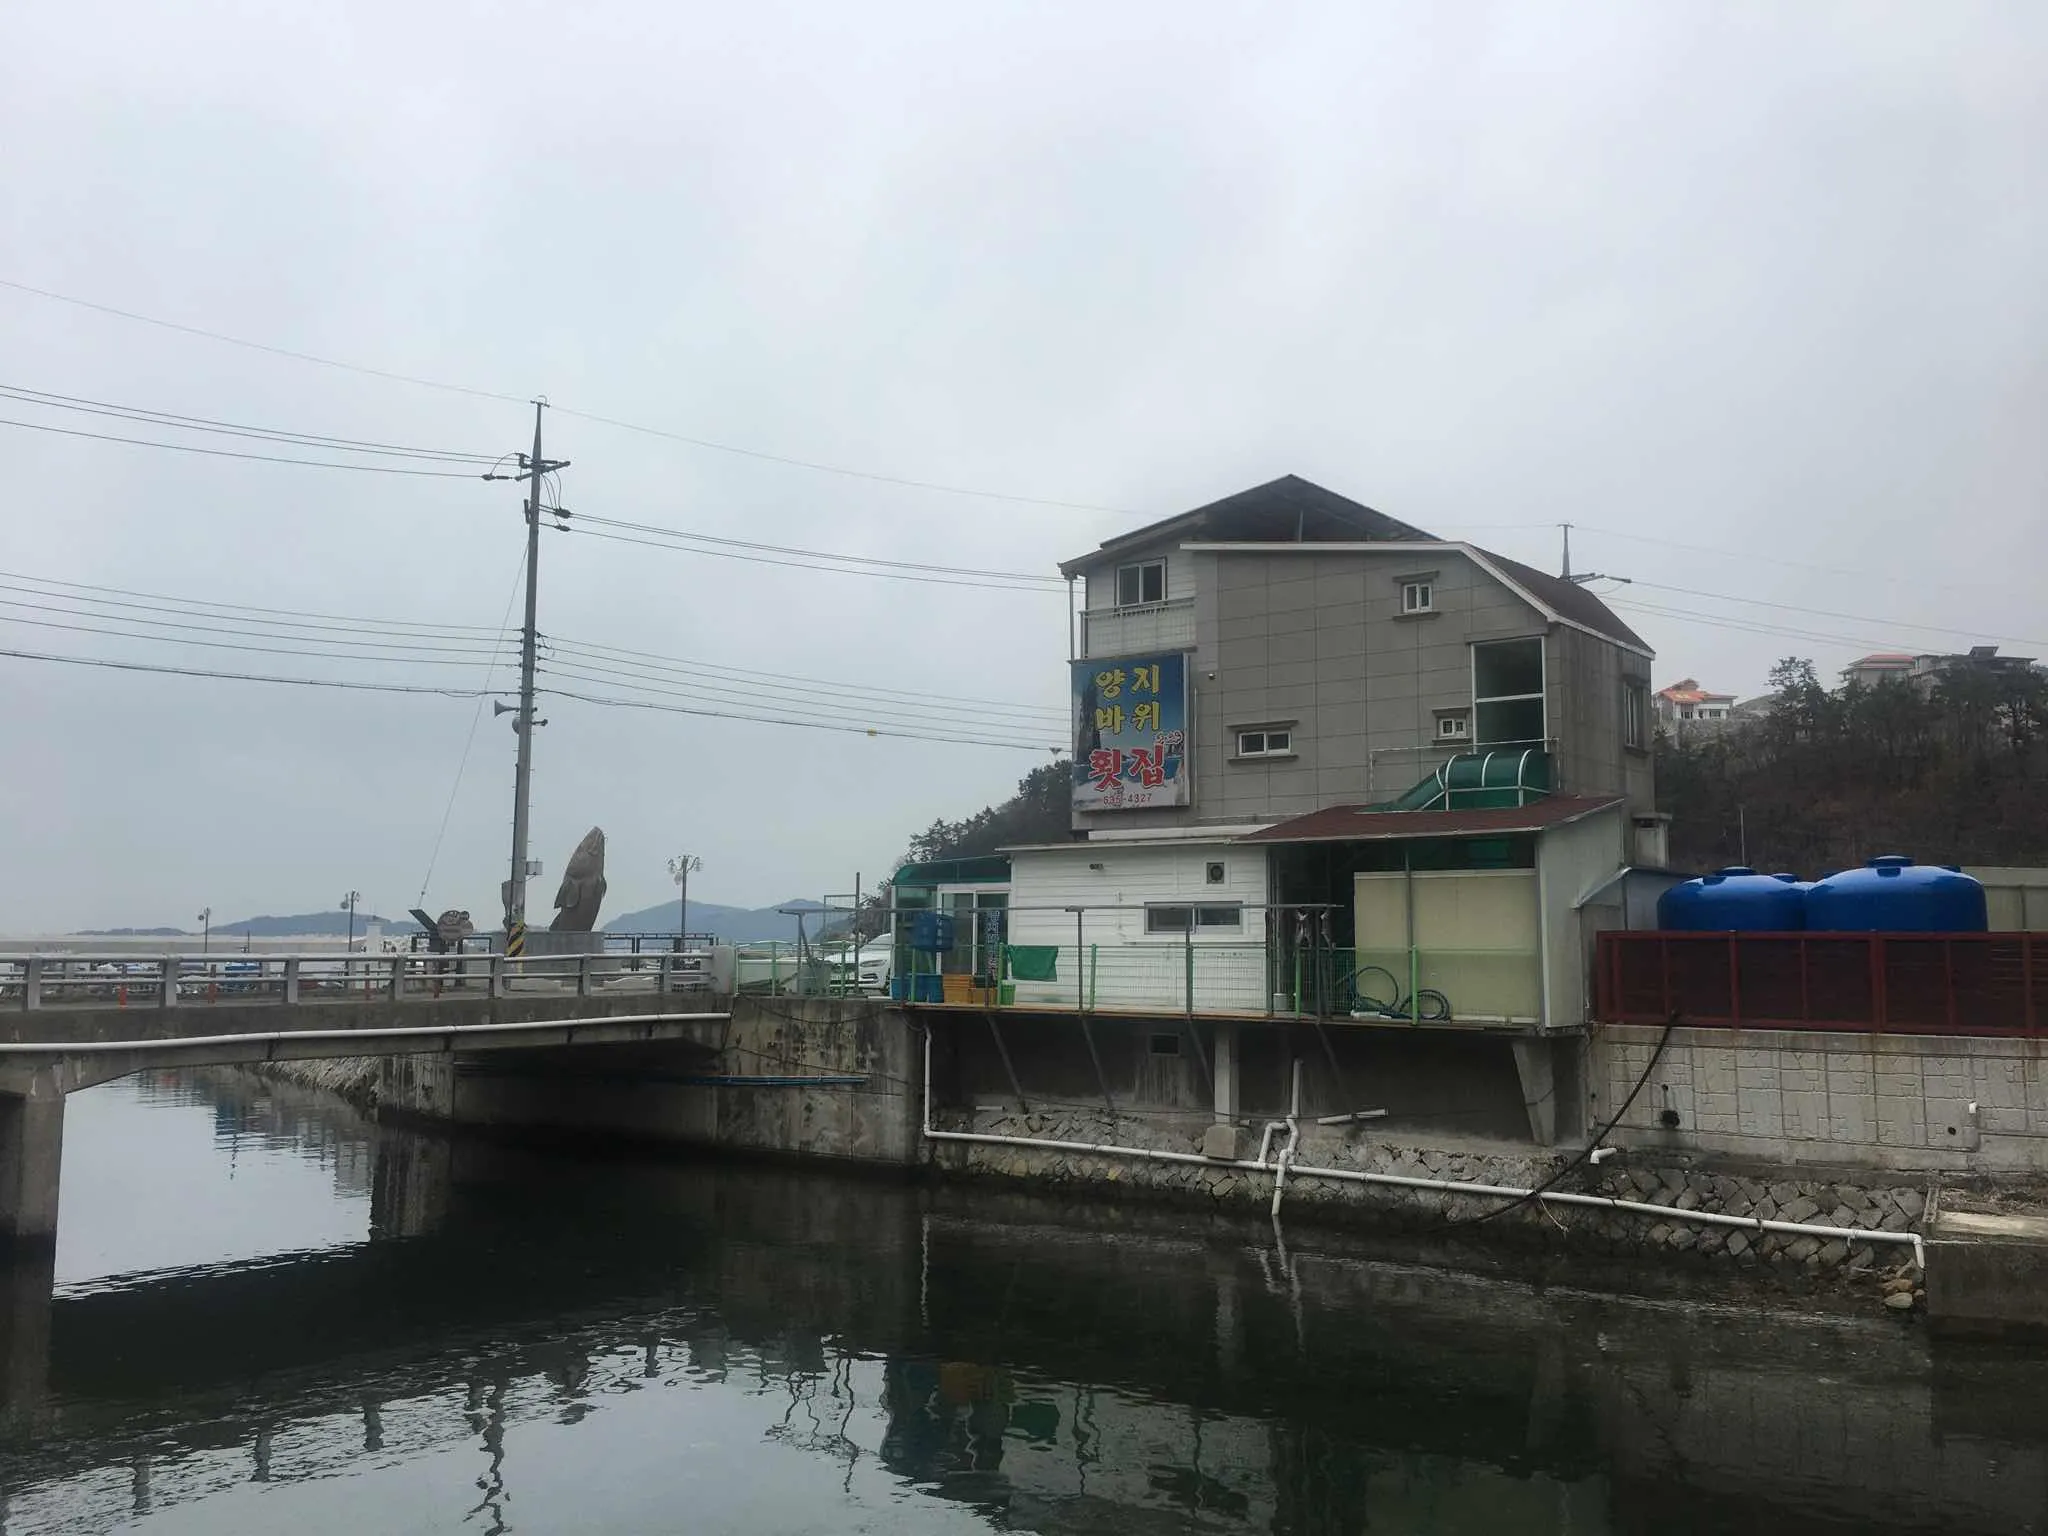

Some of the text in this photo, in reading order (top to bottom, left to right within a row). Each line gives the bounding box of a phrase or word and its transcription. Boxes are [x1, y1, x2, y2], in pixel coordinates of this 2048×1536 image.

[1095, 664, 1160, 698] 양지
[1095, 702, 1160, 734] 바위
[1088, 745, 1164, 791] 횟집
